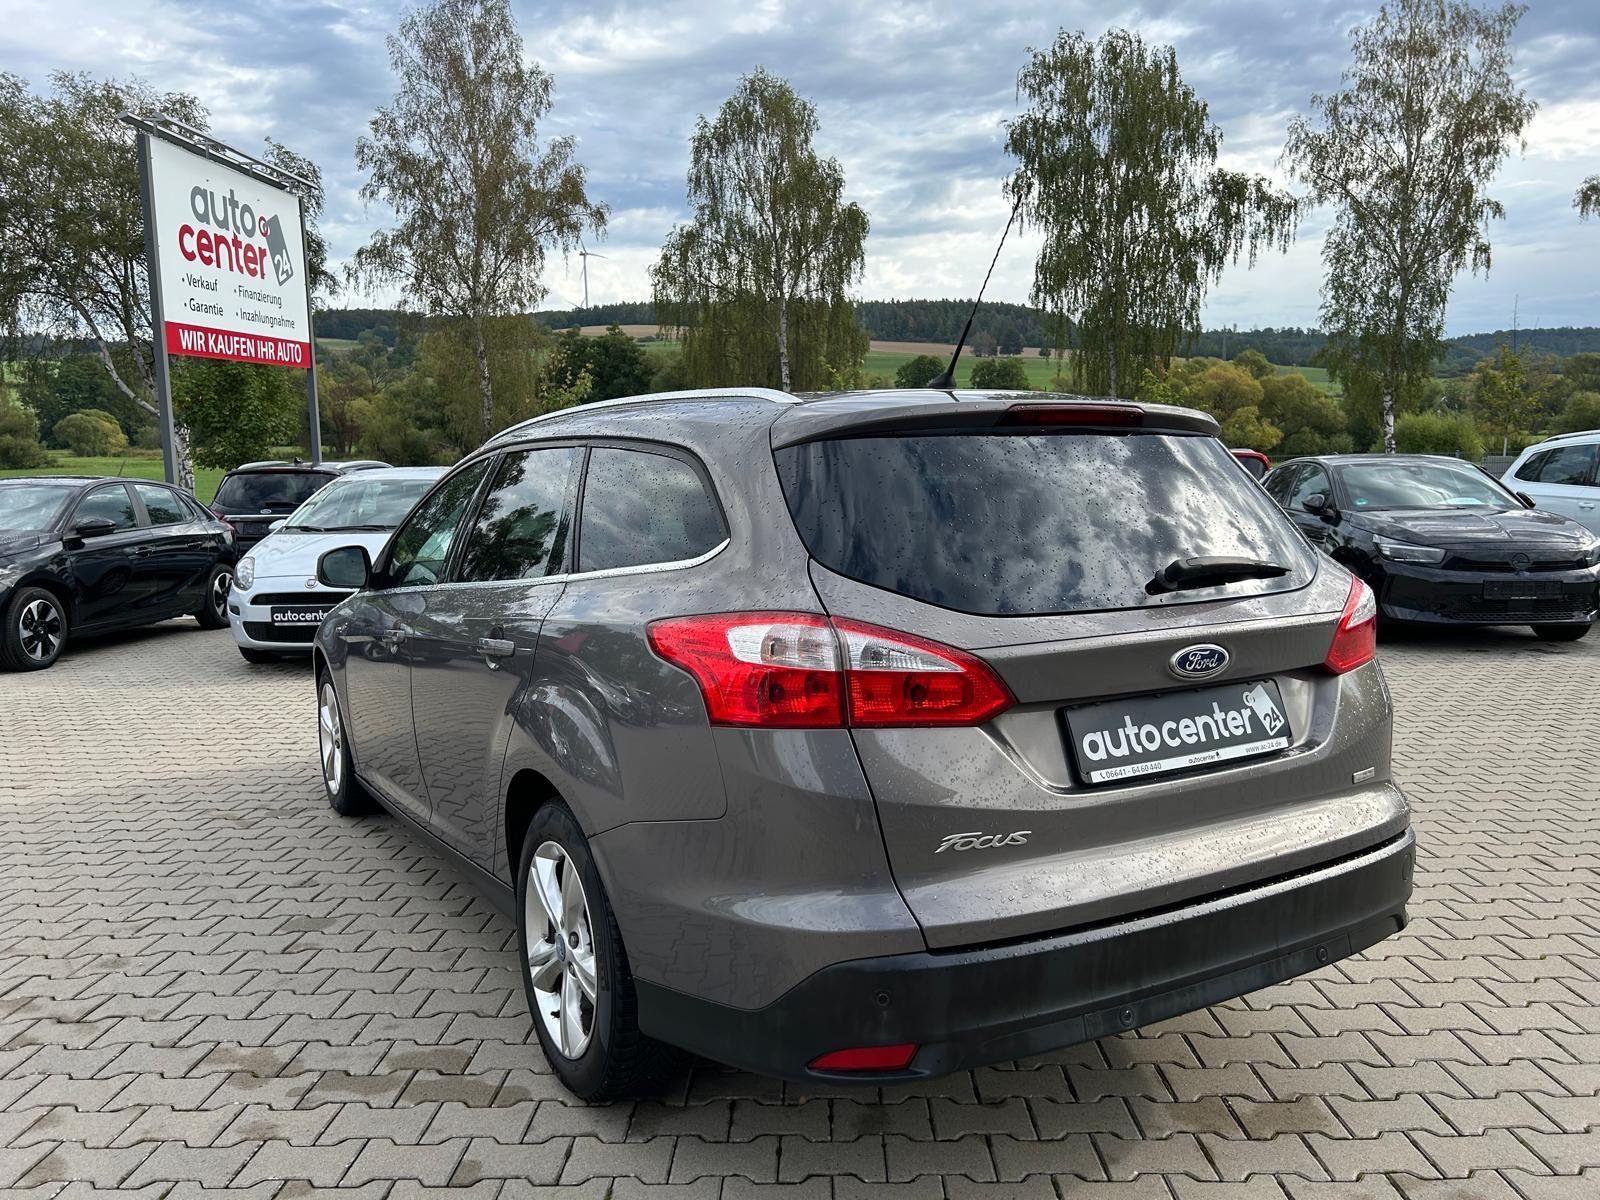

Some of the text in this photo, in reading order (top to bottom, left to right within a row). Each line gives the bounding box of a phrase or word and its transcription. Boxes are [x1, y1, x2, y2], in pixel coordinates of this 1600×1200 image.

[190, 186, 256, 238] auto
[178, 224, 292, 283] center 24
[186, 273, 218, 292] Verkauf
[189, 298, 223, 316] Garantie
[238, 285, 282, 308] Finanzierung
[240, 308, 295, 329] Inzahlungnahme
[179, 328, 302, 363] WIR KAUFEN IHR AUTO
[1186, 650, 1218, 670] Ford
[1082, 701, 1281, 761] autocenter 24
[1188, 754, 1216, 764] autocenter
